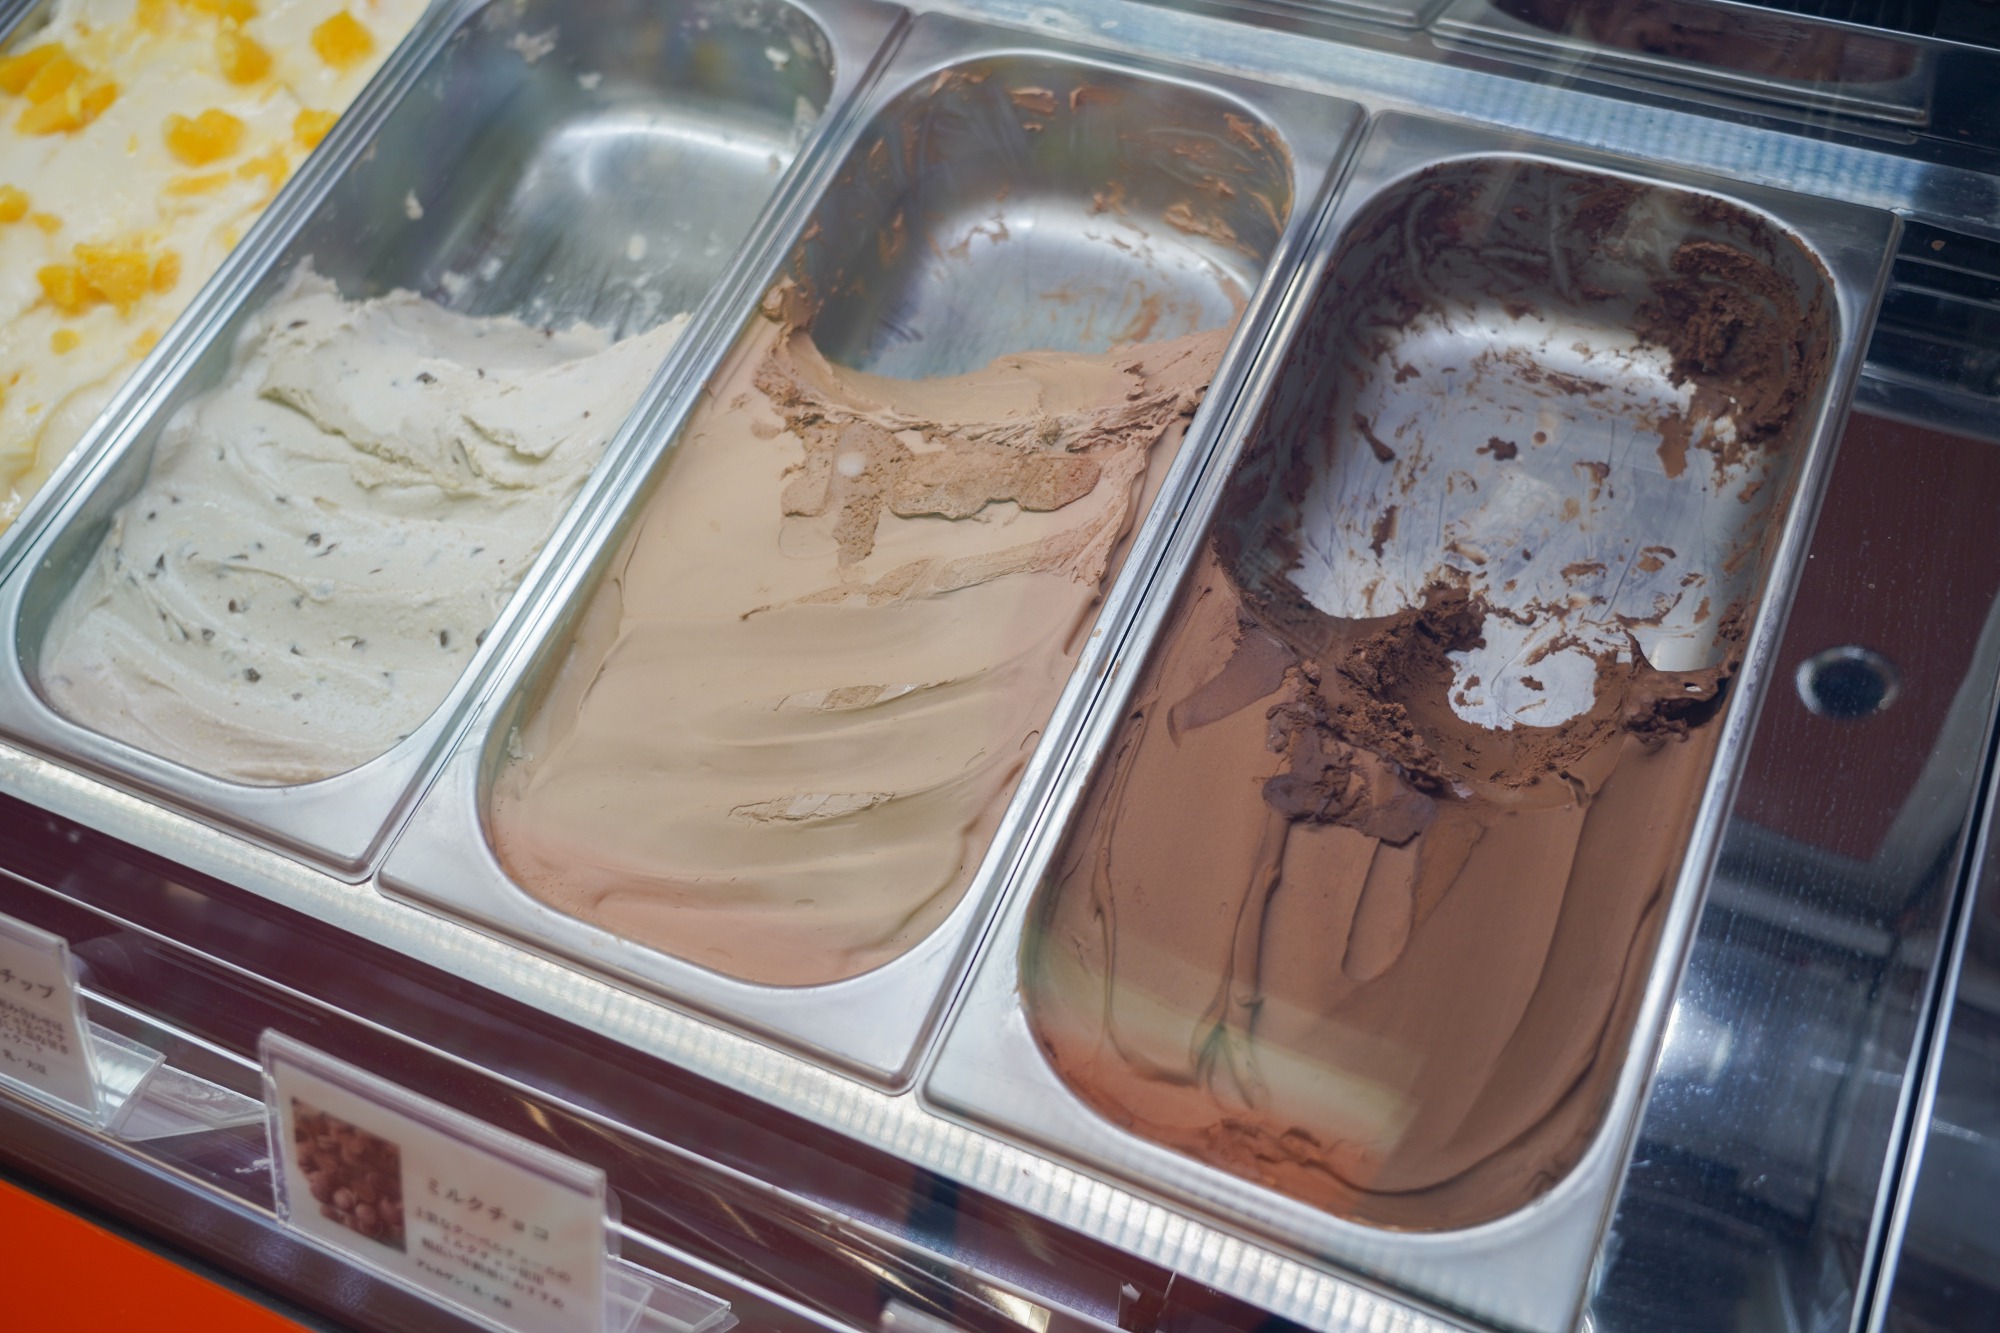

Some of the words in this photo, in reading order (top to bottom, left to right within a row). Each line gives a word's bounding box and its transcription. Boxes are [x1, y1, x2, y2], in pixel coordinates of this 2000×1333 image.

[428, 1177, 549, 1241] ミルクチョコ
